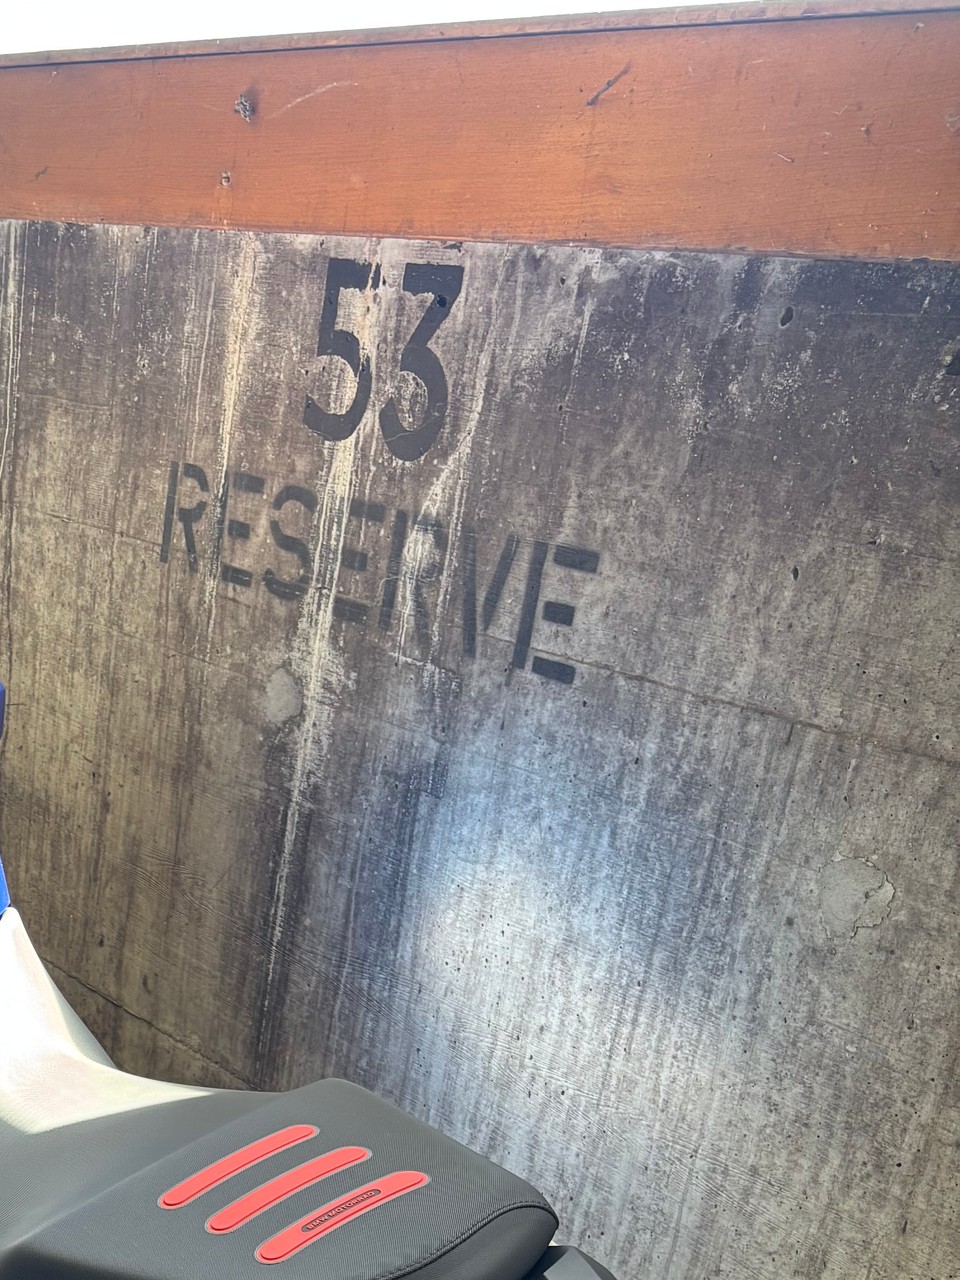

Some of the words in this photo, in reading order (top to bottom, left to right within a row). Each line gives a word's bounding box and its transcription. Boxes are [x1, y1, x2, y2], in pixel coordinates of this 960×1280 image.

[303, 258, 464, 462] 53
[159, 460, 600, 685] RESERVE
[306, 1214, 329, 1231] BMW
[329, 1191, 376, 1218] MOTORRAD
